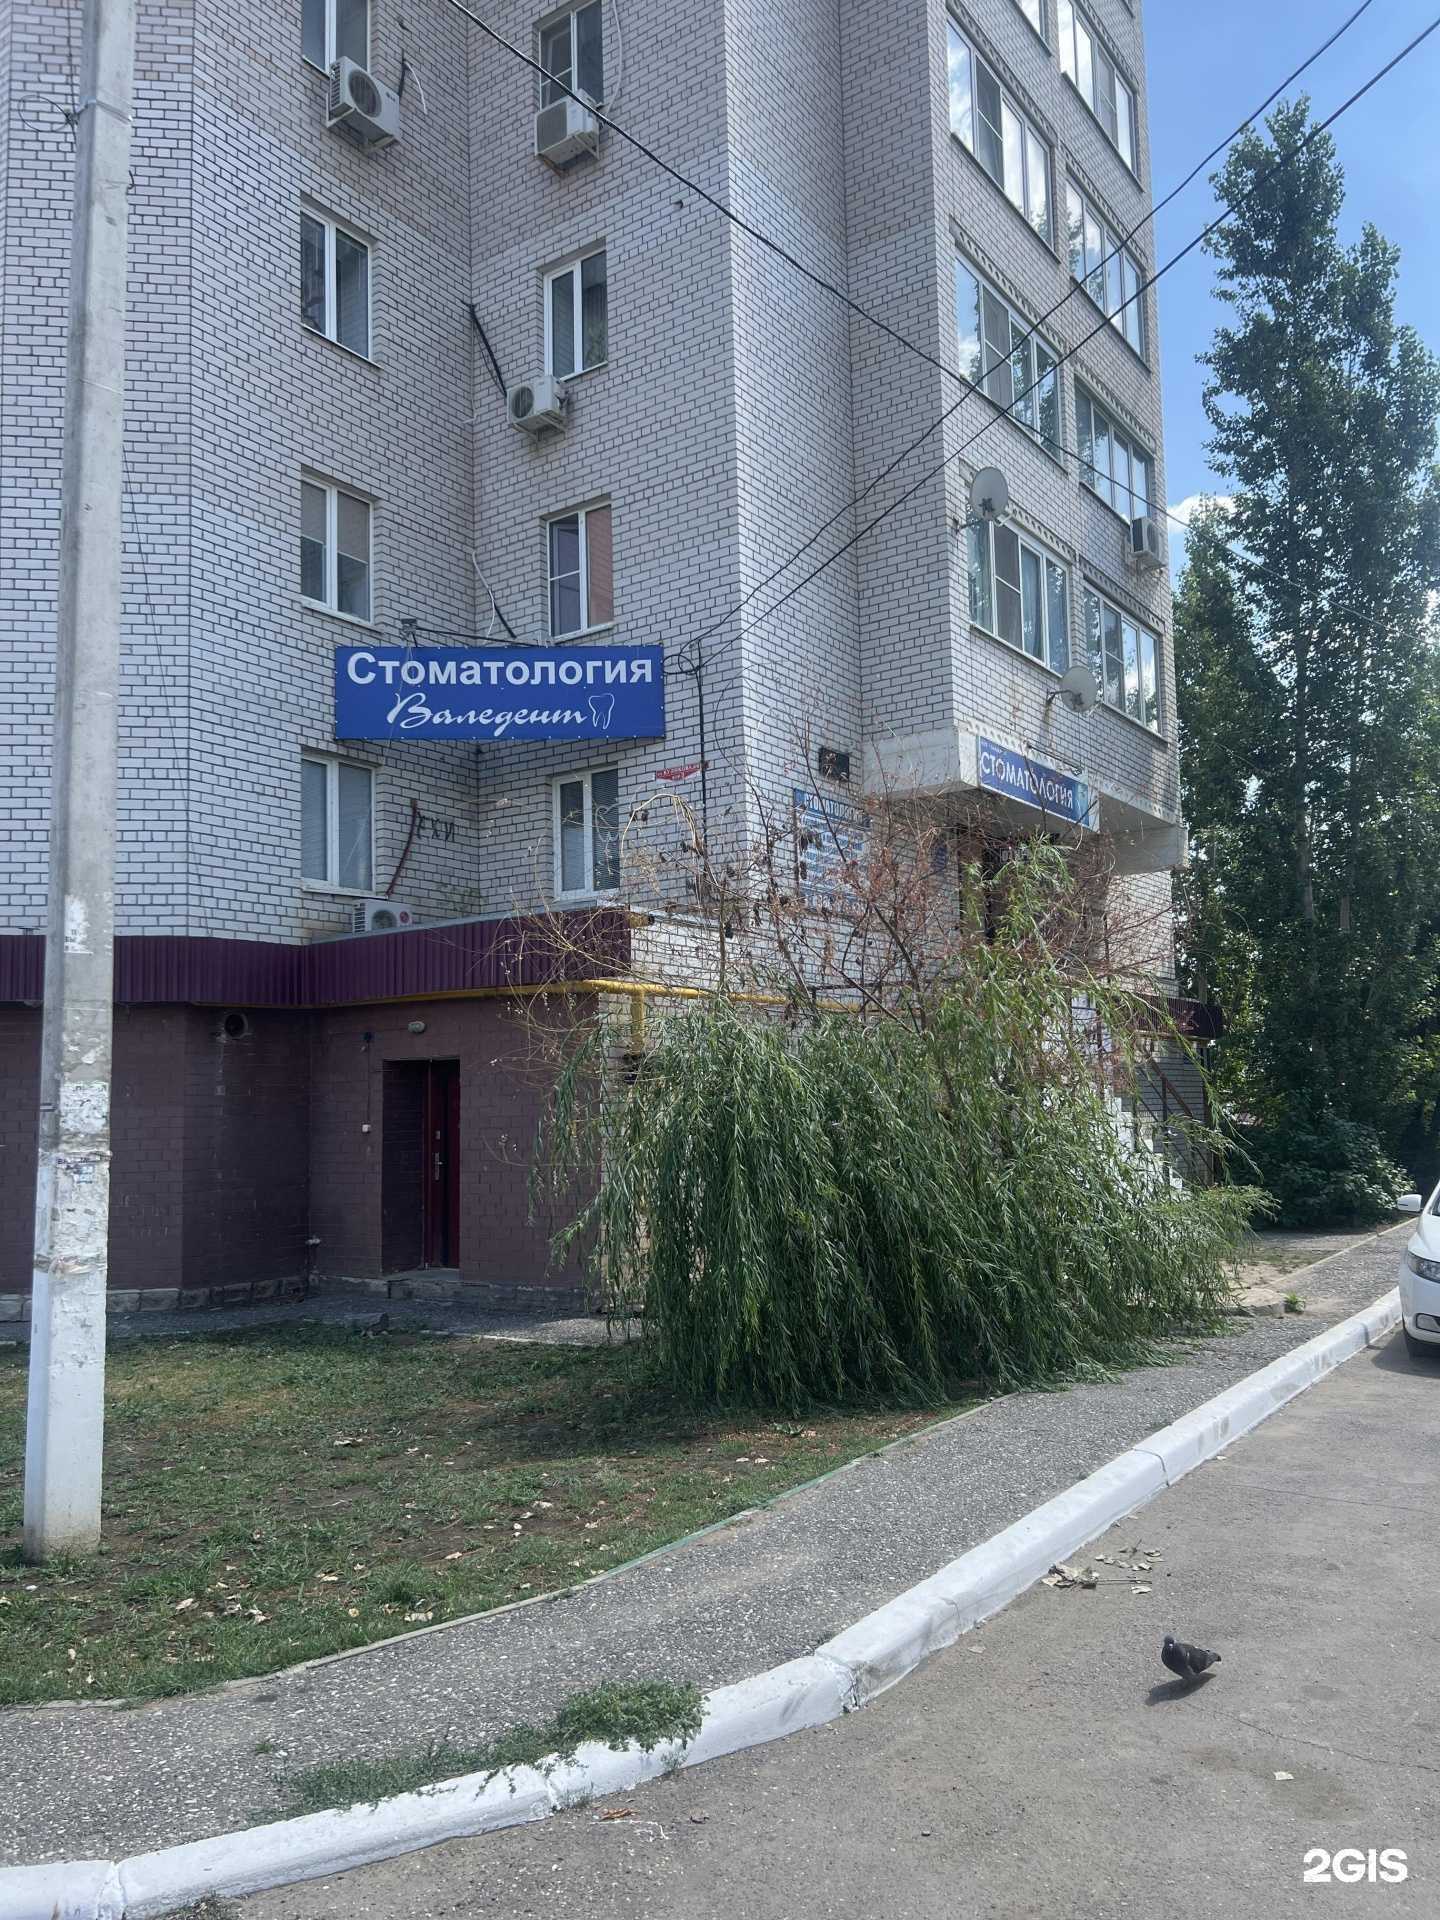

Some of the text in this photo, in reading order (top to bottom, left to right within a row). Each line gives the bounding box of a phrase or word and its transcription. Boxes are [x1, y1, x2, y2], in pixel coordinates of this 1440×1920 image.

[347, 651, 653, 686] Стоматология
[387, 692, 587, 736] Валедент
[980, 751, 1073, 809] СТОМАТОЛОГИЯ
